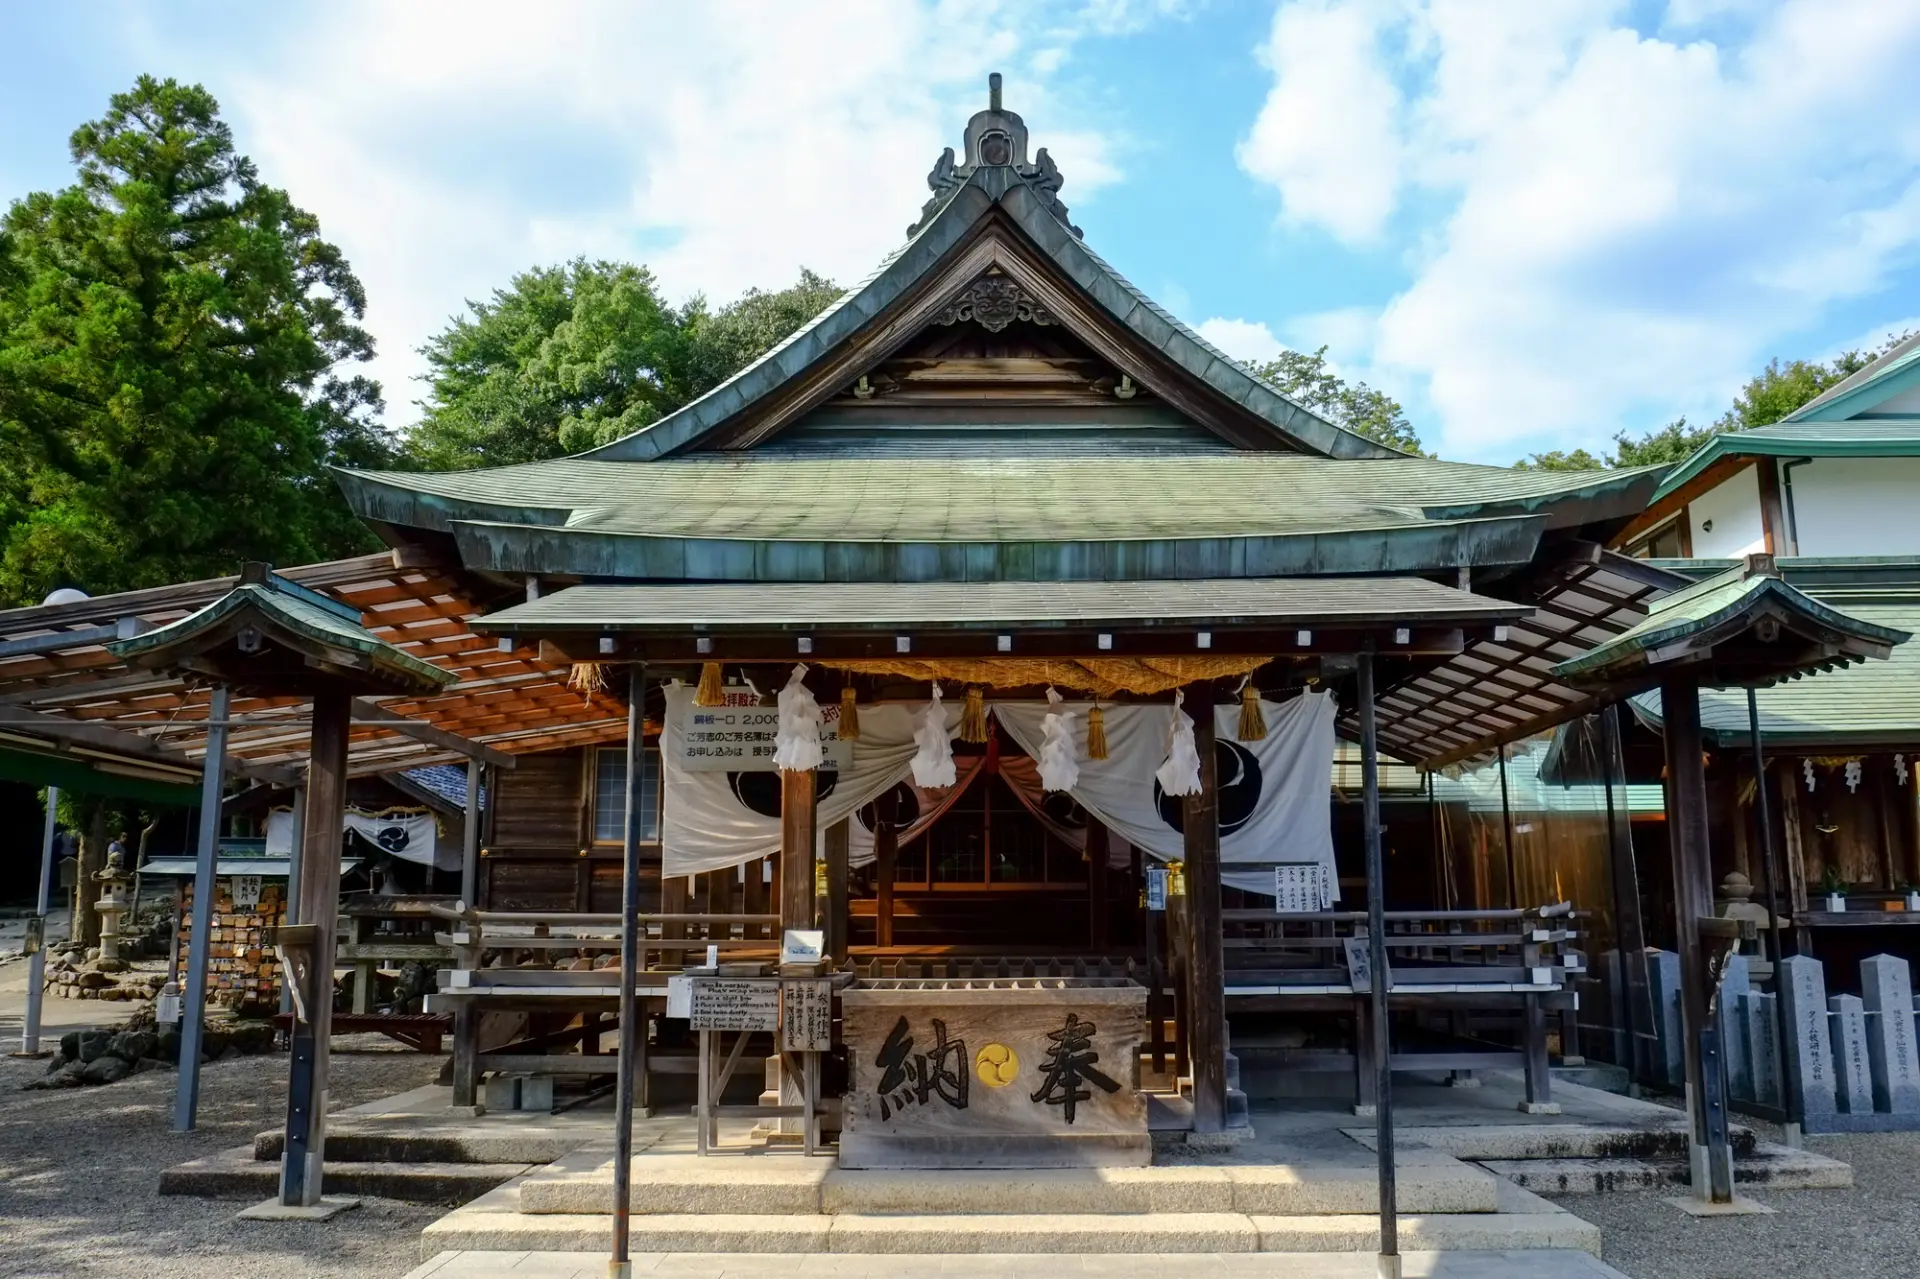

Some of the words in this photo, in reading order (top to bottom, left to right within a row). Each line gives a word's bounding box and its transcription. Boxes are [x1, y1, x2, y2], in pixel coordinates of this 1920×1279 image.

[687, 746, 743, 757] お申し込みは
[1808, 1010, 1823, 1081] タイム技研株式会社
